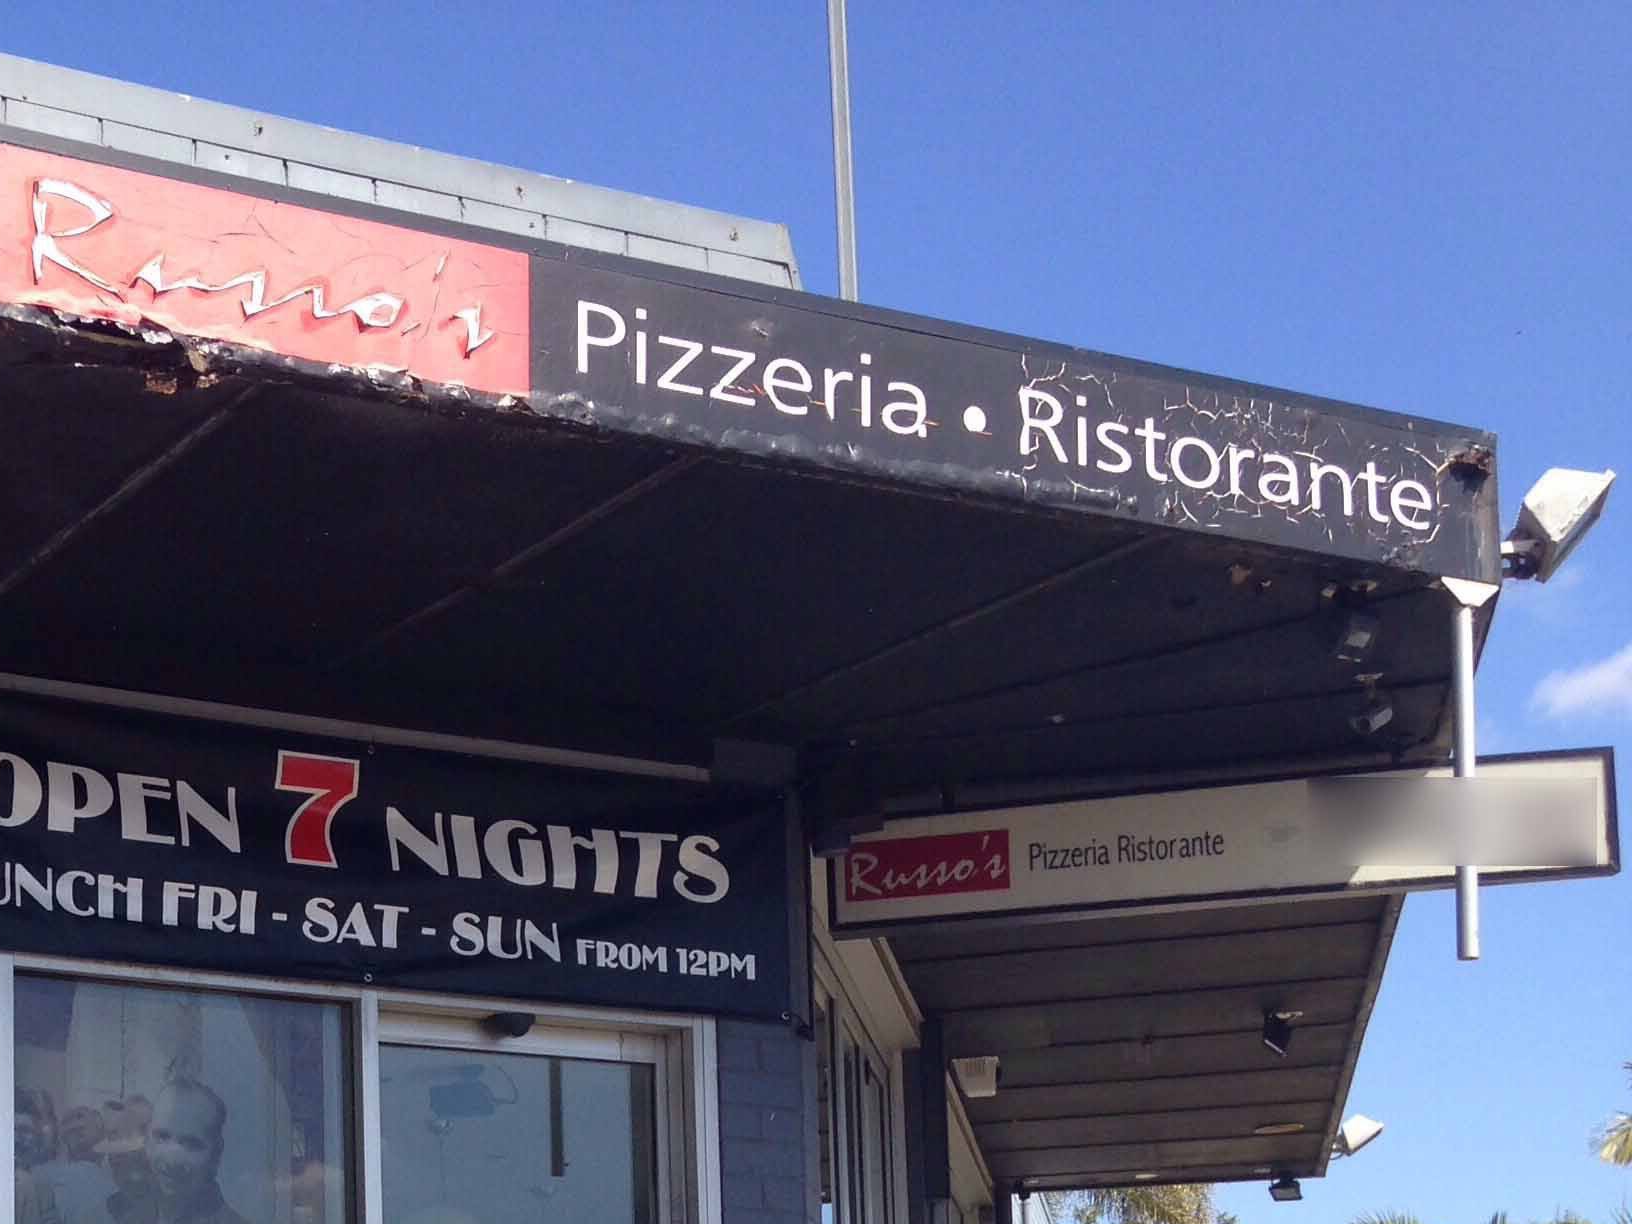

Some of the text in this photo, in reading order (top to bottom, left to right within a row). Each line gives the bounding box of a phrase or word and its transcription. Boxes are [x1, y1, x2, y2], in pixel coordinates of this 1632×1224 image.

[576, 300, 1434, 530] Pizzeria Ristorante
[274, 749, 360, 868] 7
[386, 806, 730, 904] NIGHTS
[851, 829, 1226, 896] Russo's Pizzeria Ristorante
[162, 881, 258, 935] FRI
[301, 897, 410, 950] SAT
[449, 911, 562, 963] SUN
[576, 938, 668, 973] FROM
[675, 946, 757, 981] 12PM
